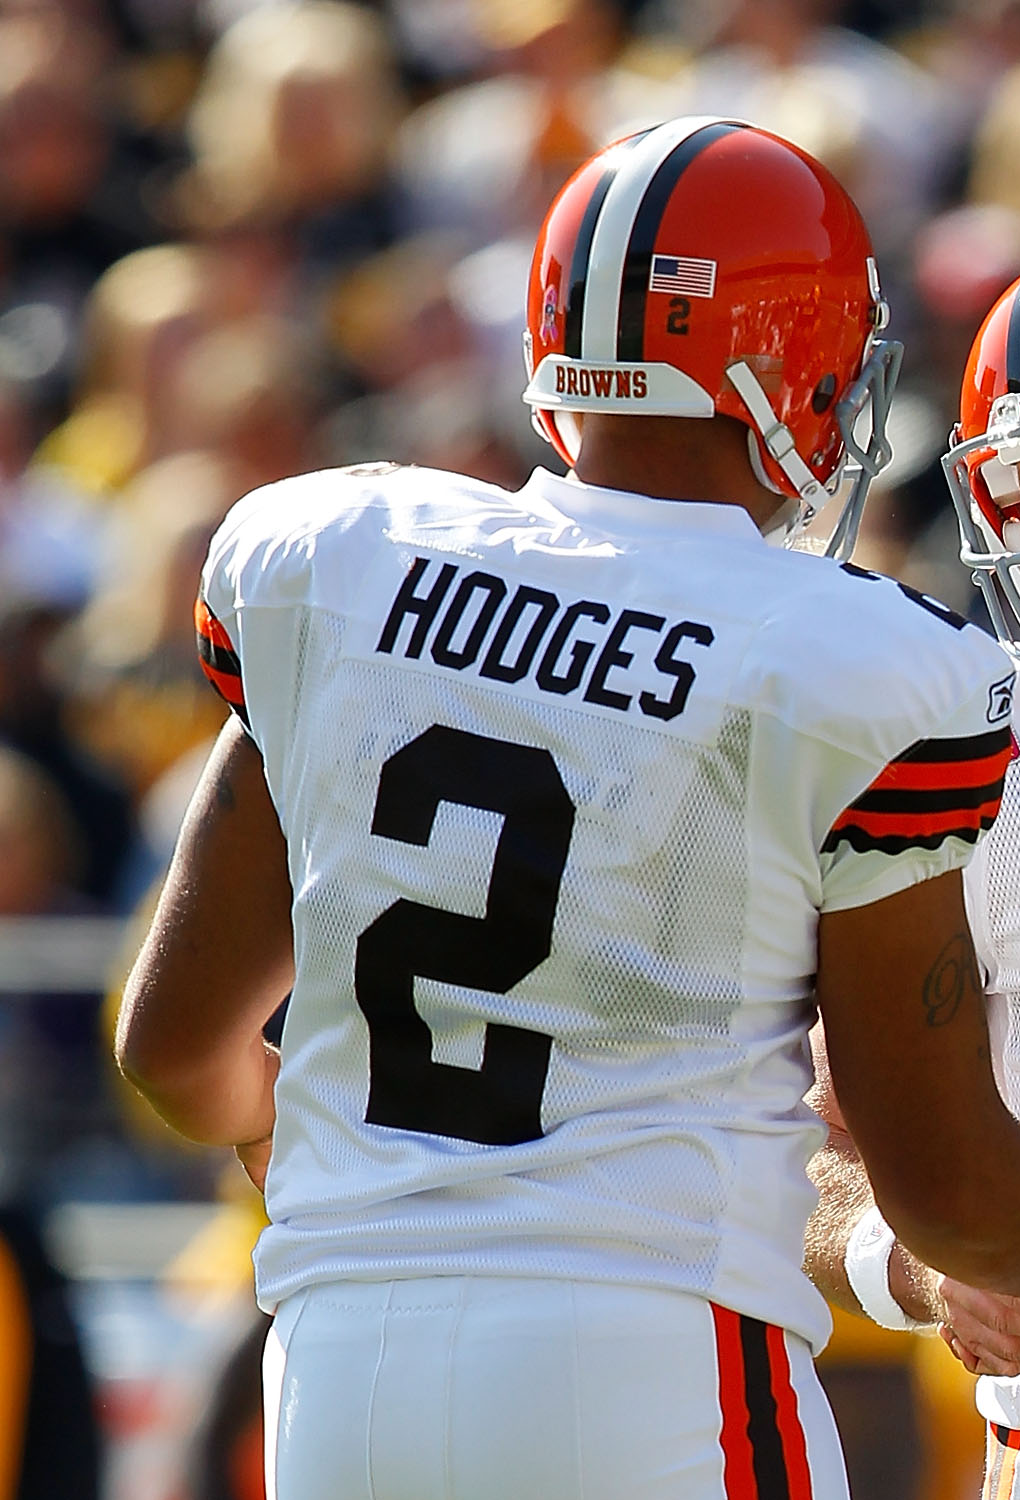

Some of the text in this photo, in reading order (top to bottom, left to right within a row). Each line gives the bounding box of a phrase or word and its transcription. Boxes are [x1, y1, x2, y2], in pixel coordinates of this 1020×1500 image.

[667, 297, 691, 335] 2
[556, 365, 647, 398] BROWNS
[375, 556, 715, 722] HODGES
[354, 723, 577, 1147] 2
